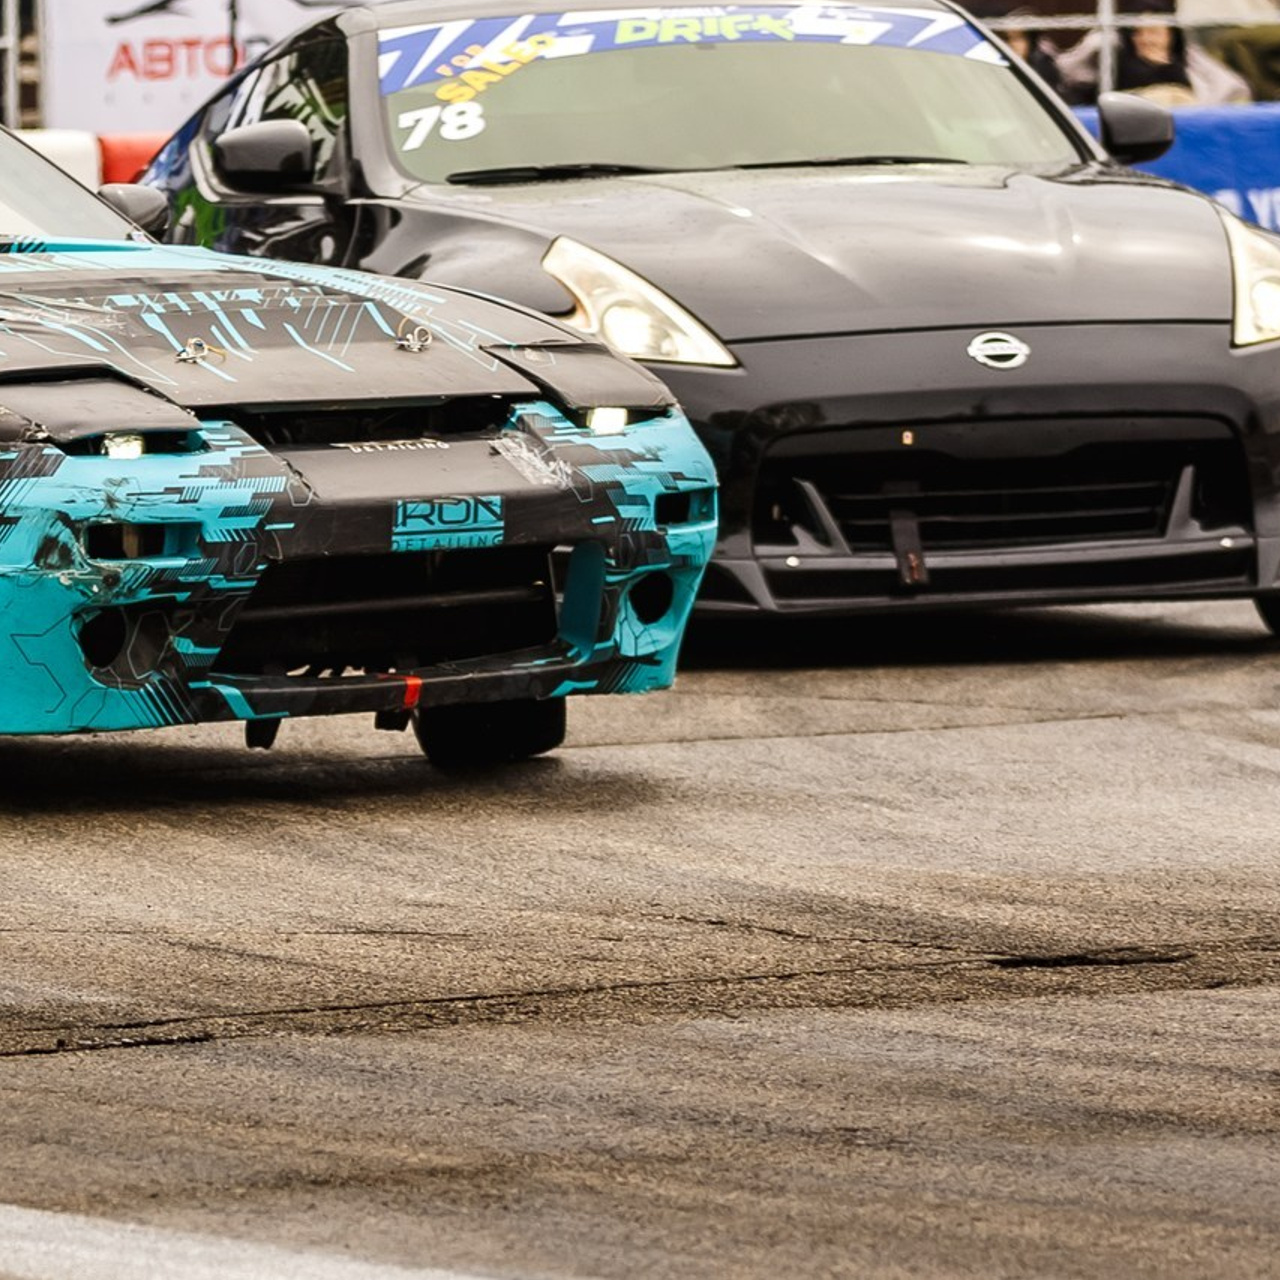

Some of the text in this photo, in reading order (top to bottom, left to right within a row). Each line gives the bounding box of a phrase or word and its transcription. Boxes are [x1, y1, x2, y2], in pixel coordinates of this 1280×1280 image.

[614, 14, 796, 44] DRIFT
[435, 40, 540, 105] SALE
[398, 101, 486, 151] 78
[394, 496, 504, 528] IRON
